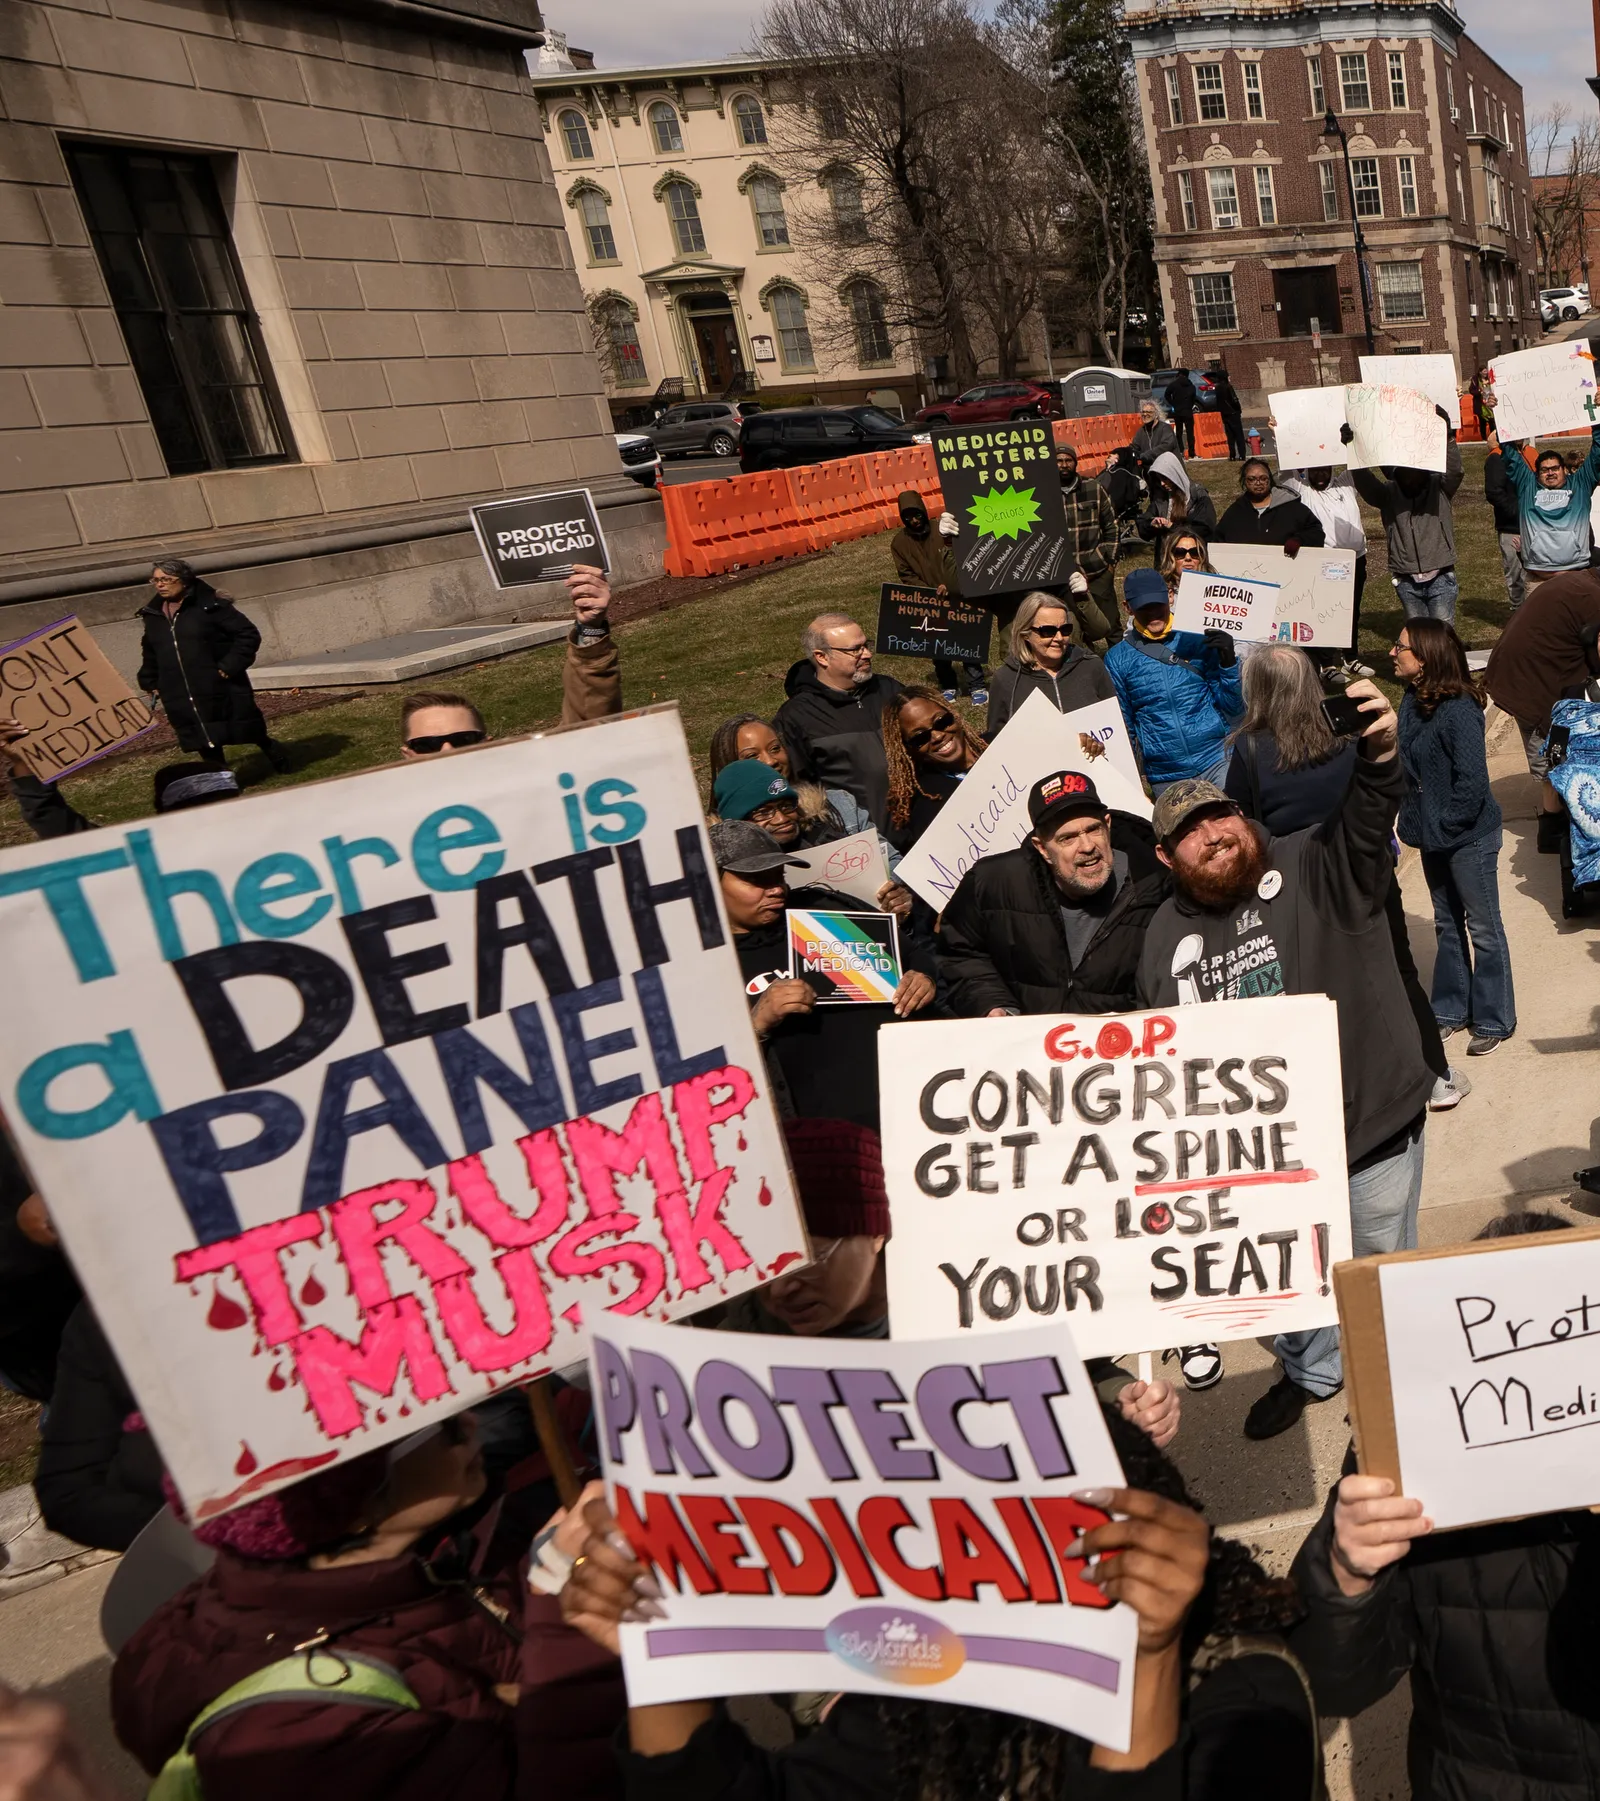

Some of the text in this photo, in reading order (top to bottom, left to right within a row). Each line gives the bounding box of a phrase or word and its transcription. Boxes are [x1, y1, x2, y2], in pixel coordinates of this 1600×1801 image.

[938, 428, 1046, 453] MEDICAID
[941, 445, 1051, 472] MATTERS
[979, 466, 1025, 485] FOR
[496, 518, 586, 546] PROTECT
[983, 505, 1025, 523] Seniors
[496, 534, 596, 561] MEDICAID
[897, 605, 940, 619] HUMAN
[1203, 585, 1254, 606] MEDICAID
[1203, 601, 1248, 618] SAVES
[1202, 616, 1243, 632] LIVES
[0, 625, 88, 698] ONT
[887, 634, 981, 659] Protect Medicaid
[10, 671, 99, 732] CUT
[20, 697, 154, 779] MEDICAID
[926, 764, 1028, 901] Medicaid
[0, 772, 648, 983] There is
[824, 852, 870, 879] Stop
[803, 956, 892, 973] MEDICAID
[805, 940, 887, 957] PROTECT
[1237, 934, 1274, 958] BOWL
[15, 825, 726, 1141] a DEATH
[1043, 1015, 1178, 1062] G.O.P.
[147, 964, 728, 1248] PANEL
[918, 1055, 1291, 1136] CONGRESS
[914, 1120, 1304, 1198] GET A SPINE
[173, 1064, 760, 1350] TRUMP
[1016, 1188, 1240, 1248] OR LOSE
[938, 1223, 1332, 1329] YOUR SEAT!
[290, 1166, 755, 1440] MUSK
[592, 1333, 1078, 1482] PROTECT
[612, 1482, 1126, 1609] MEDICAID
[839, 1630, 942, 1663] Skylands
